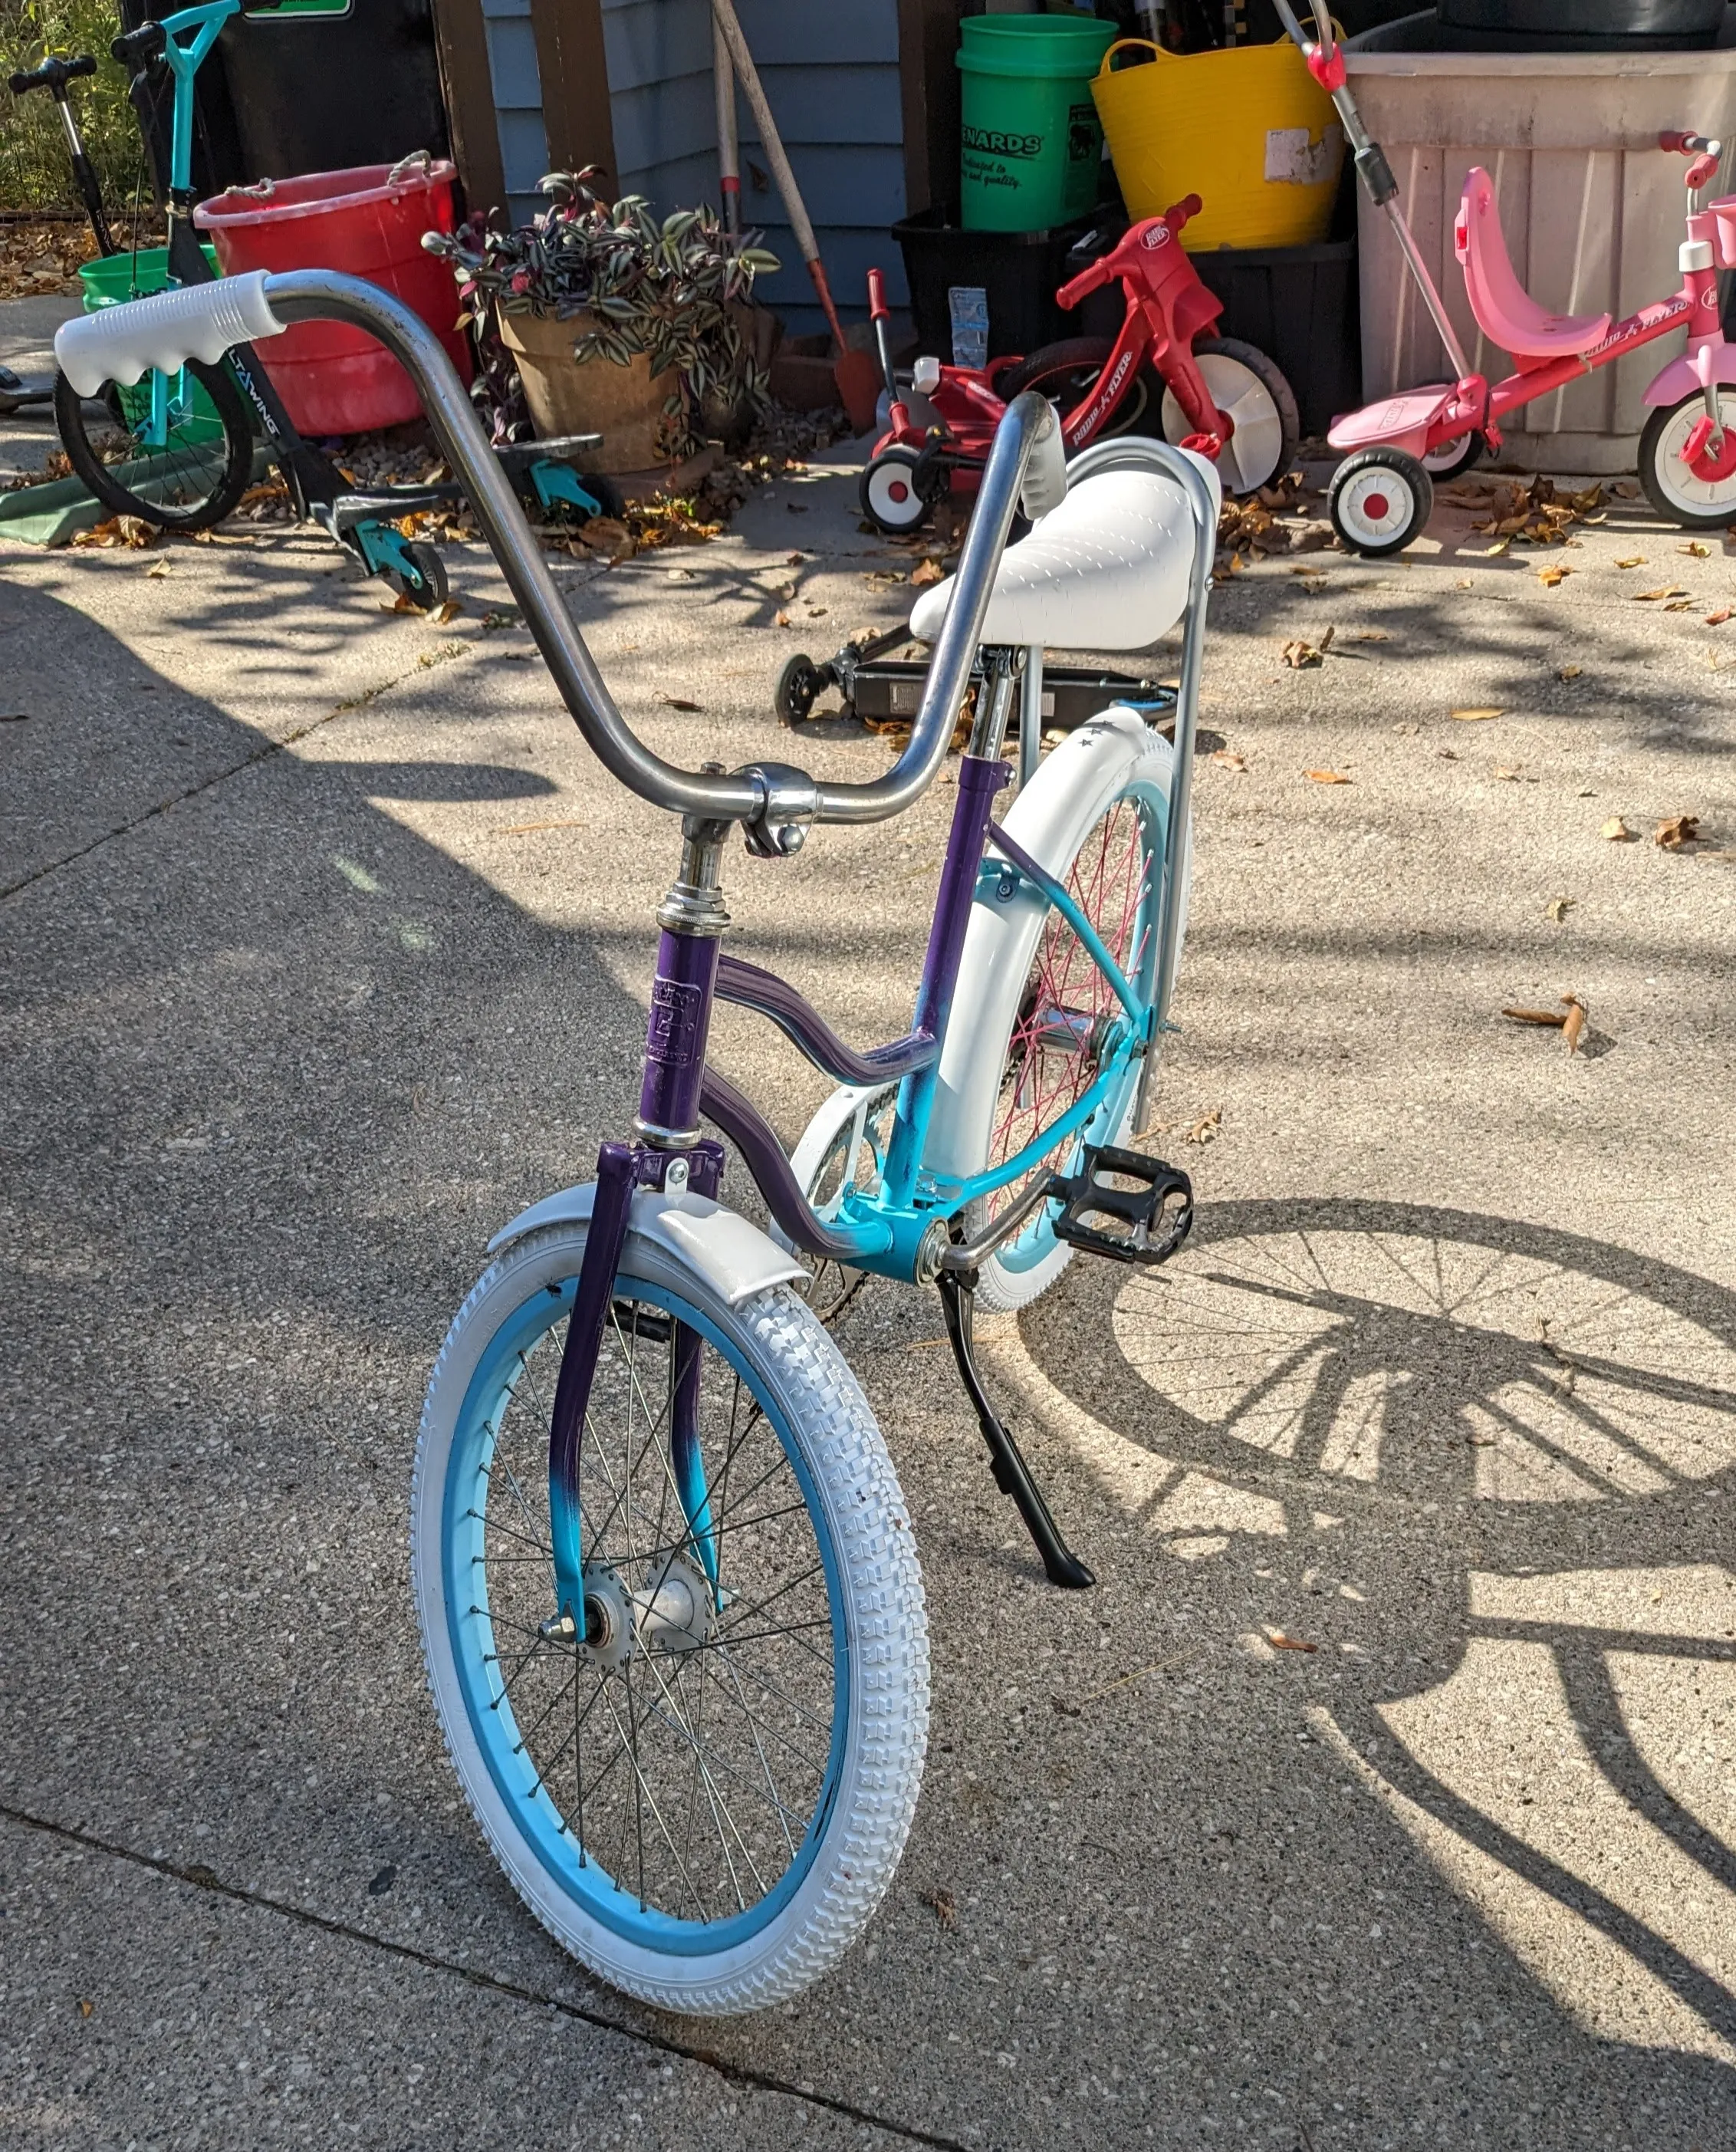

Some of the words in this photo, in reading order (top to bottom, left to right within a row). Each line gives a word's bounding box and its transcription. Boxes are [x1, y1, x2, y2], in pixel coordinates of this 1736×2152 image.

[962, 126, 1041, 155] ENARDS
[996, 163, 1006, 173] to
[228, 349, 281, 436] LTAWING
[1072, 406, 1100, 446] RADIO
[1107, 350, 1133, 397] FLYER
